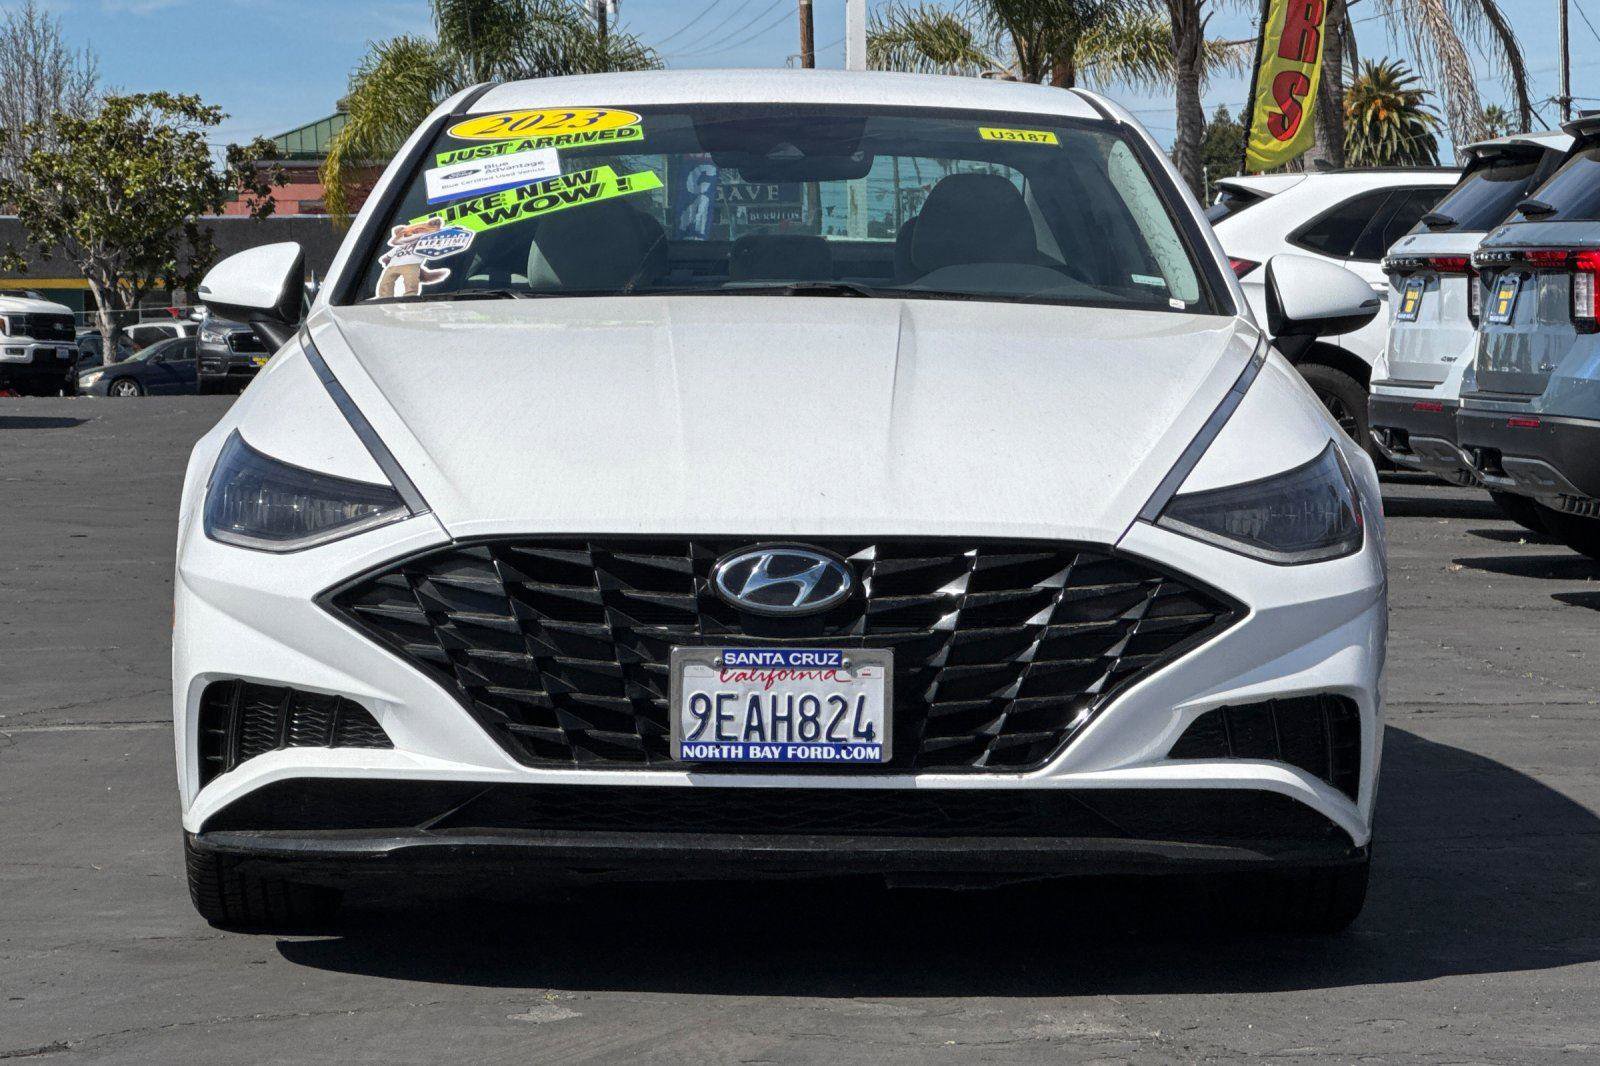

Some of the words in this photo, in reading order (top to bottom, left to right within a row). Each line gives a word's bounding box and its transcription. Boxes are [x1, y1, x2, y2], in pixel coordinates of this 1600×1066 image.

[473, 111, 608, 135] 2023
[441, 142, 513, 165] JUST
[515, 127, 639, 151] ARRIVED
[990, 131, 1048, 142] U3187
[484, 161, 509, 170] Blue
[485, 160, 545, 175] Advantage
[515, 170, 598, 201] NEW
[478, 183, 606, 225] WOW
[724, 652, 785, 665] SANTA
[789, 652, 839, 665] CRUZ
[719, 667, 852, 691] California
[687, 692, 876, 742] 9EAH824
[682, 745, 743, 759] NORTH
[750, 745, 781, 759] BAY
[787, 745, 880, 760] FORD.COM
